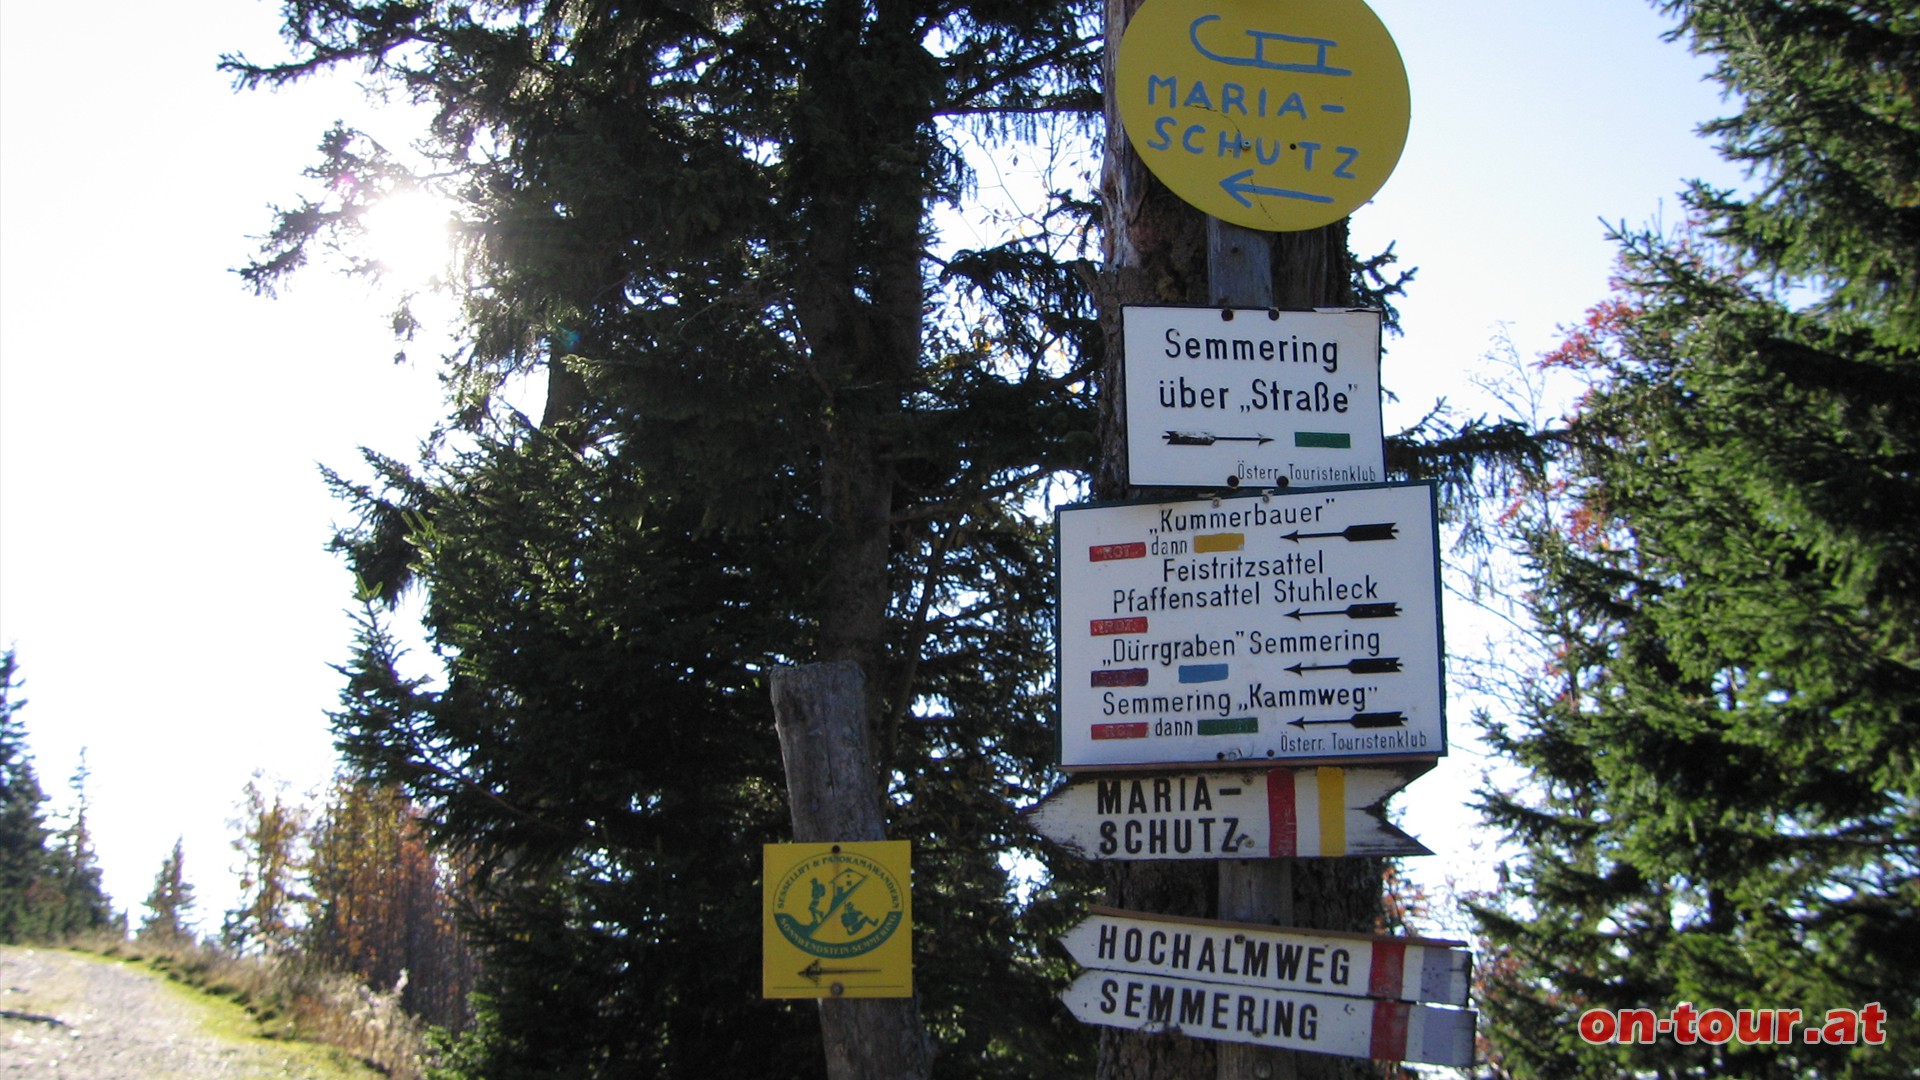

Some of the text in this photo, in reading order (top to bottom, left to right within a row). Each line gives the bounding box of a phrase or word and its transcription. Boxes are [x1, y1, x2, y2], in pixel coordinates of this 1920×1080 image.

[1148, 75, 1345, 120] MARIA-
[1147, 117, 1359, 179] SCHUTZ
[1165, 328, 1338, 373] Semmering
[1159, 377, 1229, 410] über
[1288, 464, 1376, 482] Touristenklub
[1151, 535, 1188, 555] dann
[1163, 551, 1324, 582] Feistritzsattel
[1113, 575, 1378, 613] Pfaffensattel Stuhleck
[1250, 631, 1381, 655] Semmering
[1102, 688, 1232, 716] Semmering
[1155, 718, 1193, 737] dann
[1280, 731, 1427, 752] Österr. Touristenklub
[1098, 776, 1242, 815] MARIA-
[1099, 817, 1240, 856] SCHUTZ
[1098, 924, 1351, 986] HOCHALMWEG
[1100, 979, 1319, 1041] SEMMERING
